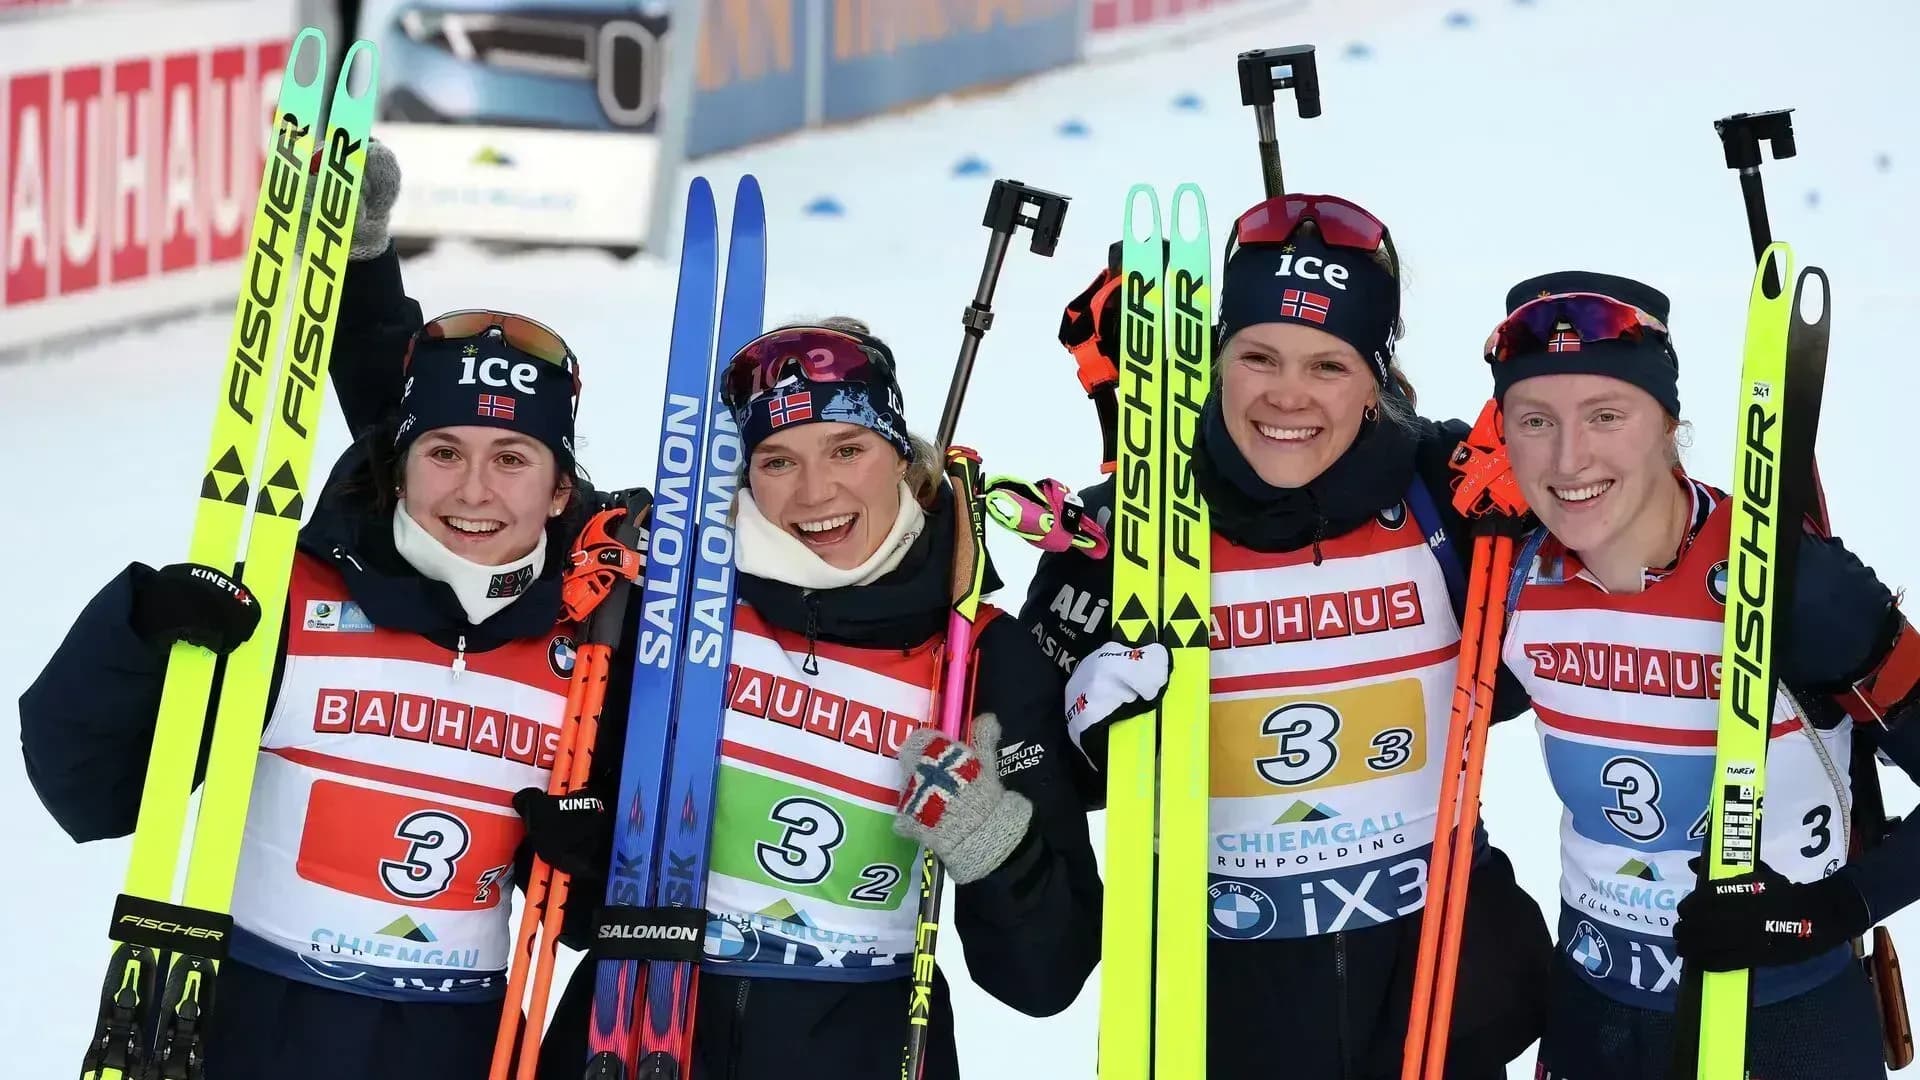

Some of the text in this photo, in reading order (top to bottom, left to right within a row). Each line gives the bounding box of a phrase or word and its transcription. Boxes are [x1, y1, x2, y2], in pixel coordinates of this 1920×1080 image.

[228, 113, 310, 425] FISCHER
[282, 127, 361, 439] FISCHER
[1275, 248, 1349, 290] ice
[458, 350, 538, 394] ice
[1122, 270, 1155, 569] FISCHER
[1172, 269, 1203, 570] FISCHER
[639, 394, 700, 668] SALOMON
[971, 502, 983, 536] LEKI
[490, 583, 523, 597] SEA
[492, 567, 533, 586] NOVA
[1733, 403, 1776, 730] FISCHER
[1210, 585, 1416, 642] AUHAUS
[1530, 648, 1722, 691] BAUHAUS
[320, 694, 560, 761] BAUHAUS
[730, 674, 913, 752] AUHAU
[1253, 702, 1340, 786] 3
[1367, 728, 1413, 771] 3
[1600, 756, 1666, 843] 3
[378, 808, 471, 901] 3
[754, 796, 846, 886] 3
[1216, 812, 1406, 855] CHIEMGAU
[1217, 833, 1406, 869] RUHPOLDING
[1800, 804, 1832, 858] 3
[849, 863, 901, 904] 2
[1301, 858, 1429, 936] iX3
[120, 914, 224, 941] FISCHER
[598, 924, 699, 942] SALOMON
[910, 922, 938, 1026] LEKI
